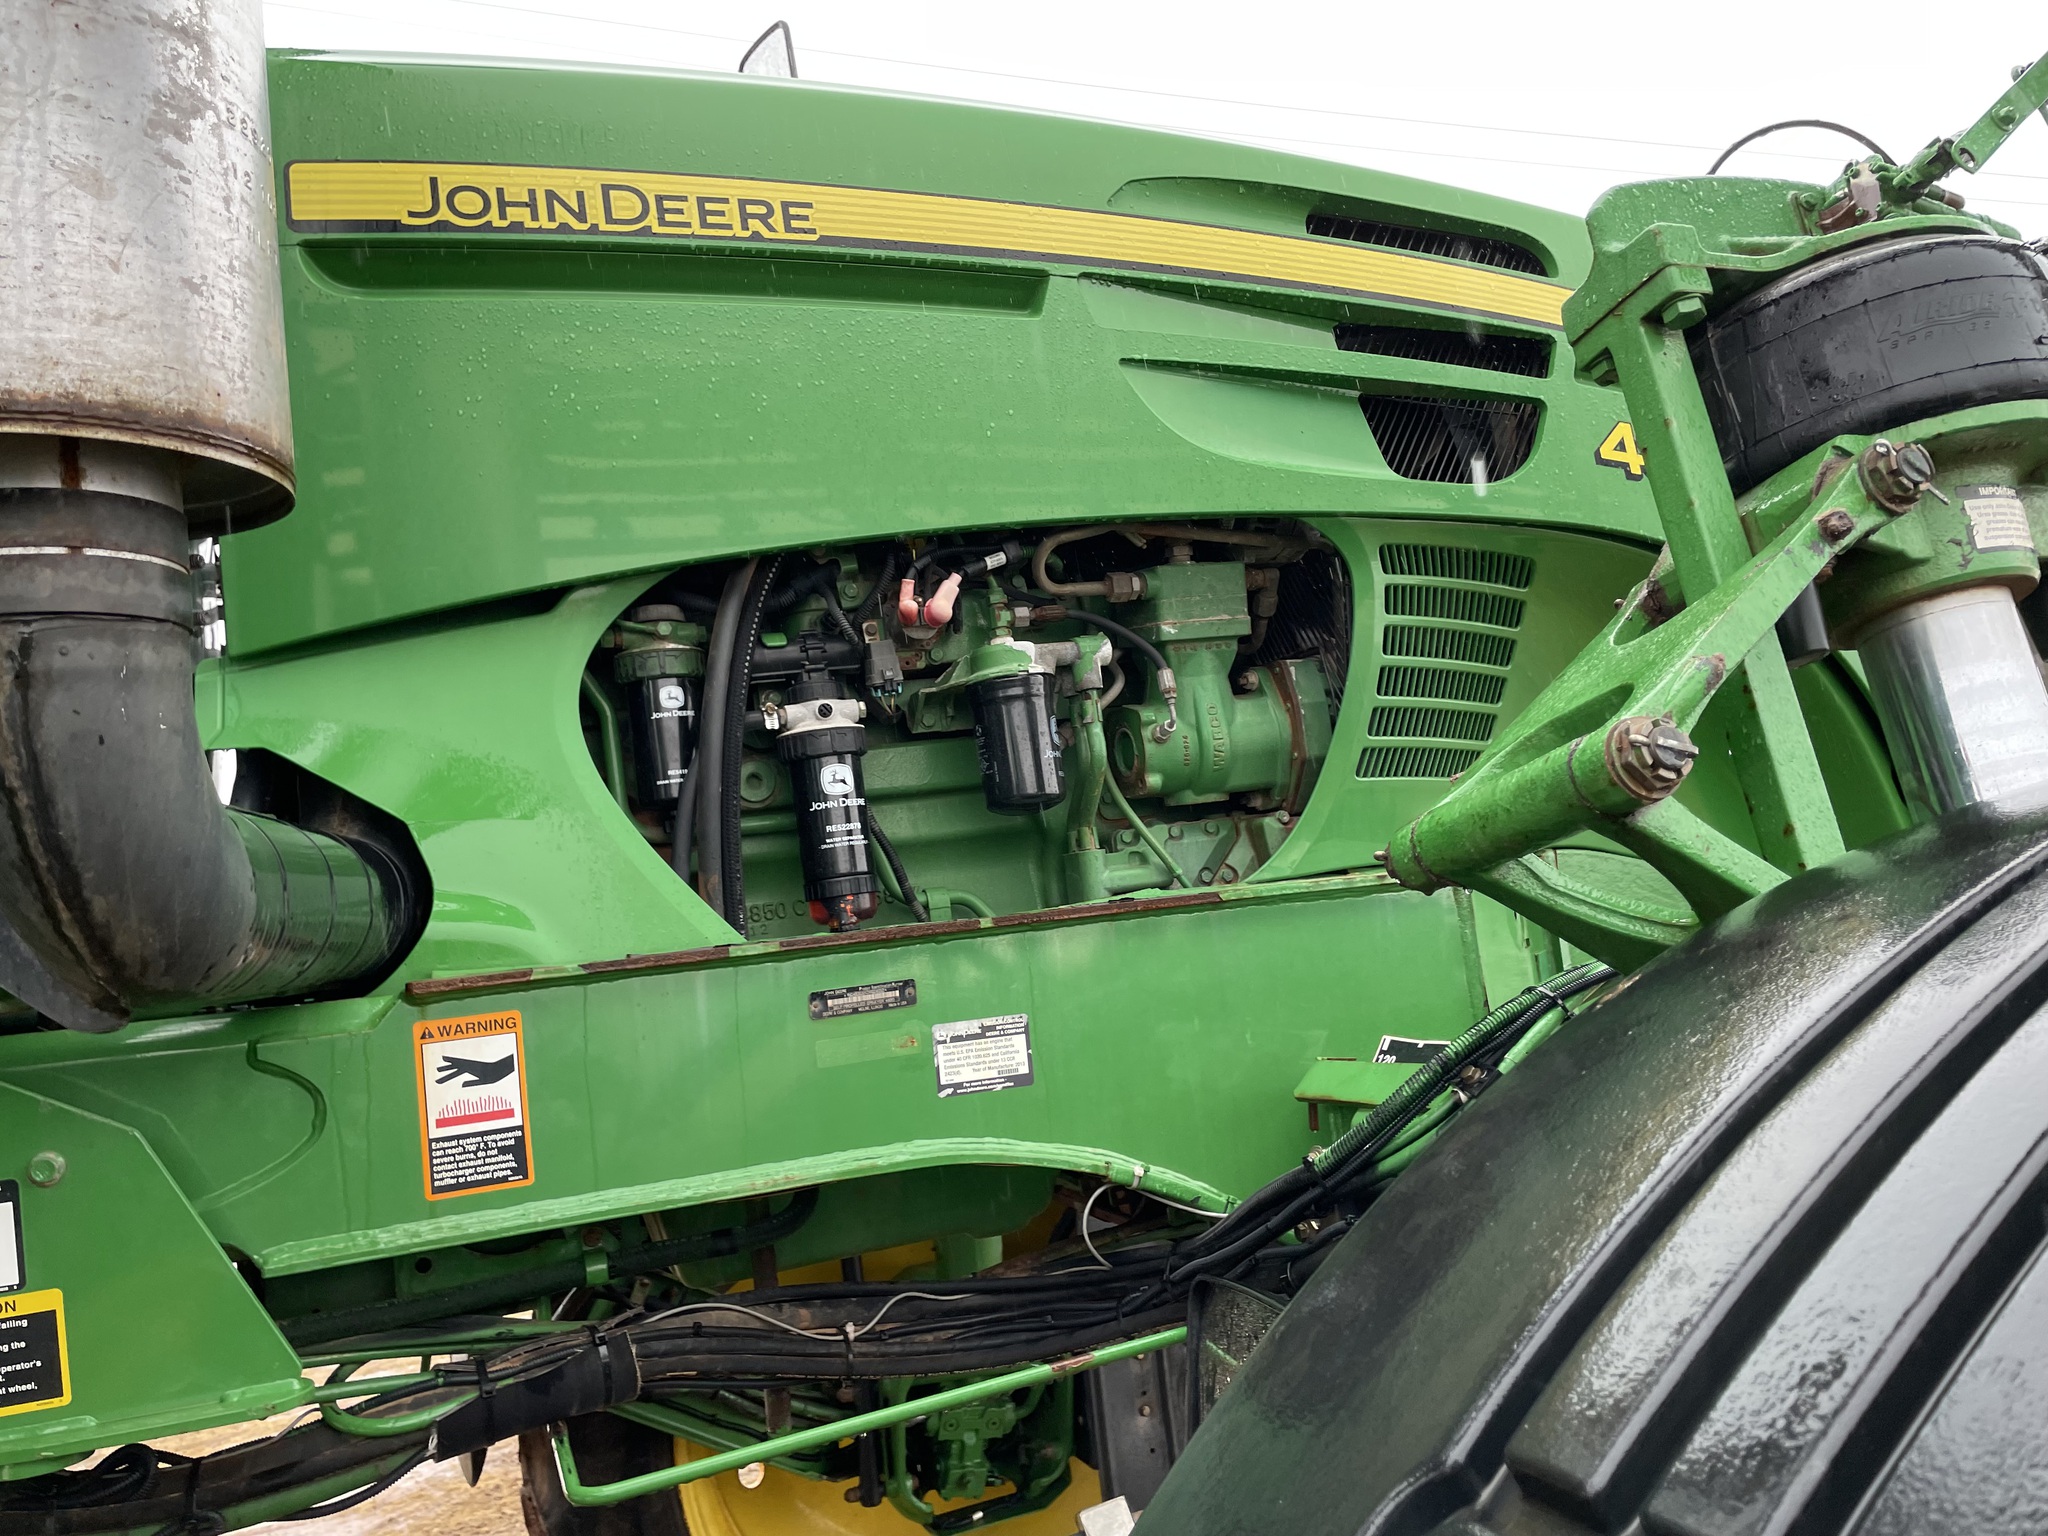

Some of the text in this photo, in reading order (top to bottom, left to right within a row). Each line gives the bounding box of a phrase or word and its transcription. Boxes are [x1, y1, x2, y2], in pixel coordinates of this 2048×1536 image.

[407, 176, 816, 235] JOHN DEERE
[650, 710, 695, 720] JOHN DEERE
[1206, 702, 1225, 772] WABCO
[809, 798, 866, 812] JOHN DEERE
[437, 1017, 517, 1038] WARNING
[952, 1042, 974, 1050] equipment
[431, 1130, 522, 1150] Exhaust system components
[445, 1146, 464, 1155] reach
[497, 1138, 515, 1147] avoid
[433, 1152, 514, 1172] contact exhaust manifold,
[455, 1152, 476, 1161] burns,
[487, 1148, 498, 1156] not
[434, 1161, 518, 1180] turbocharger components,
[434, 1177, 457, 1187] muffler
[467, 1172, 492, 1181] exhaust
[493, 1170, 513, 1179] pipes.
[10, 1341, 26, 1350] the
[0, 1360, 42, 1374] perator's
[8, 1381, 38, 1394] wheel,
